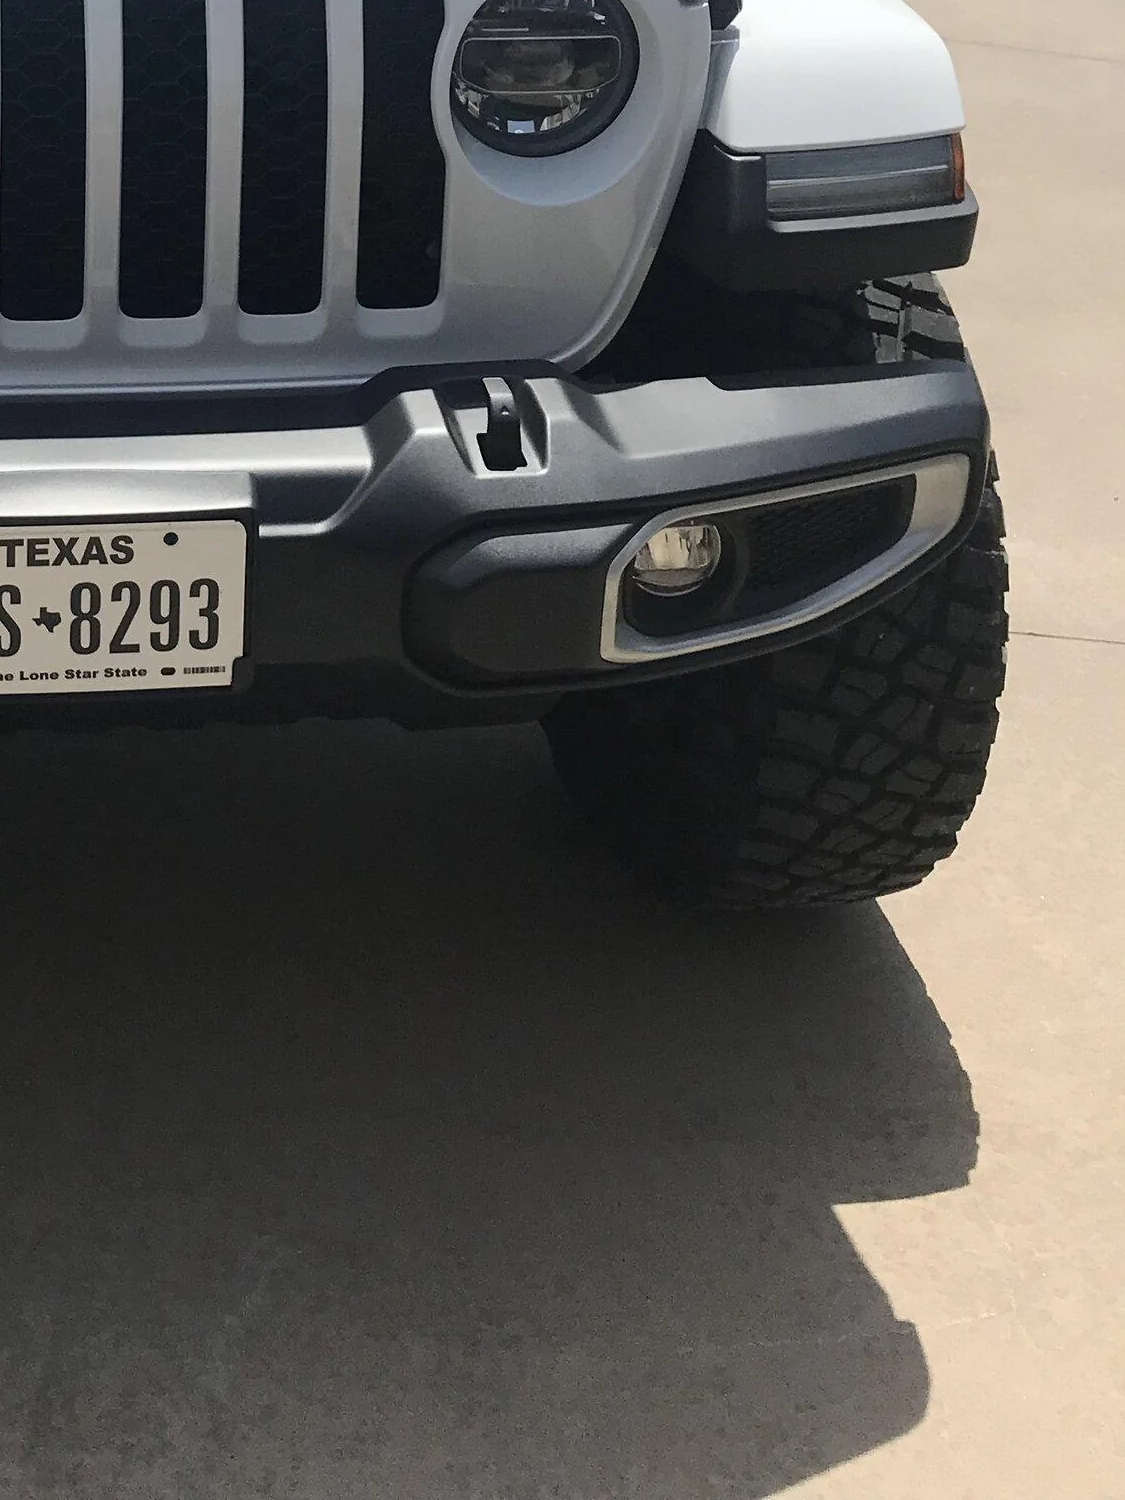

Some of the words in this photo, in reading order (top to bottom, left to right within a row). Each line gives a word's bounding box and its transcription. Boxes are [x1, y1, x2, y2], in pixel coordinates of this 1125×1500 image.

[69, 577, 221, 656] 8293
[19, 669, 60, 681] Lone
[64, 668, 100, 680] Star
[103, 666, 148, 678] State
